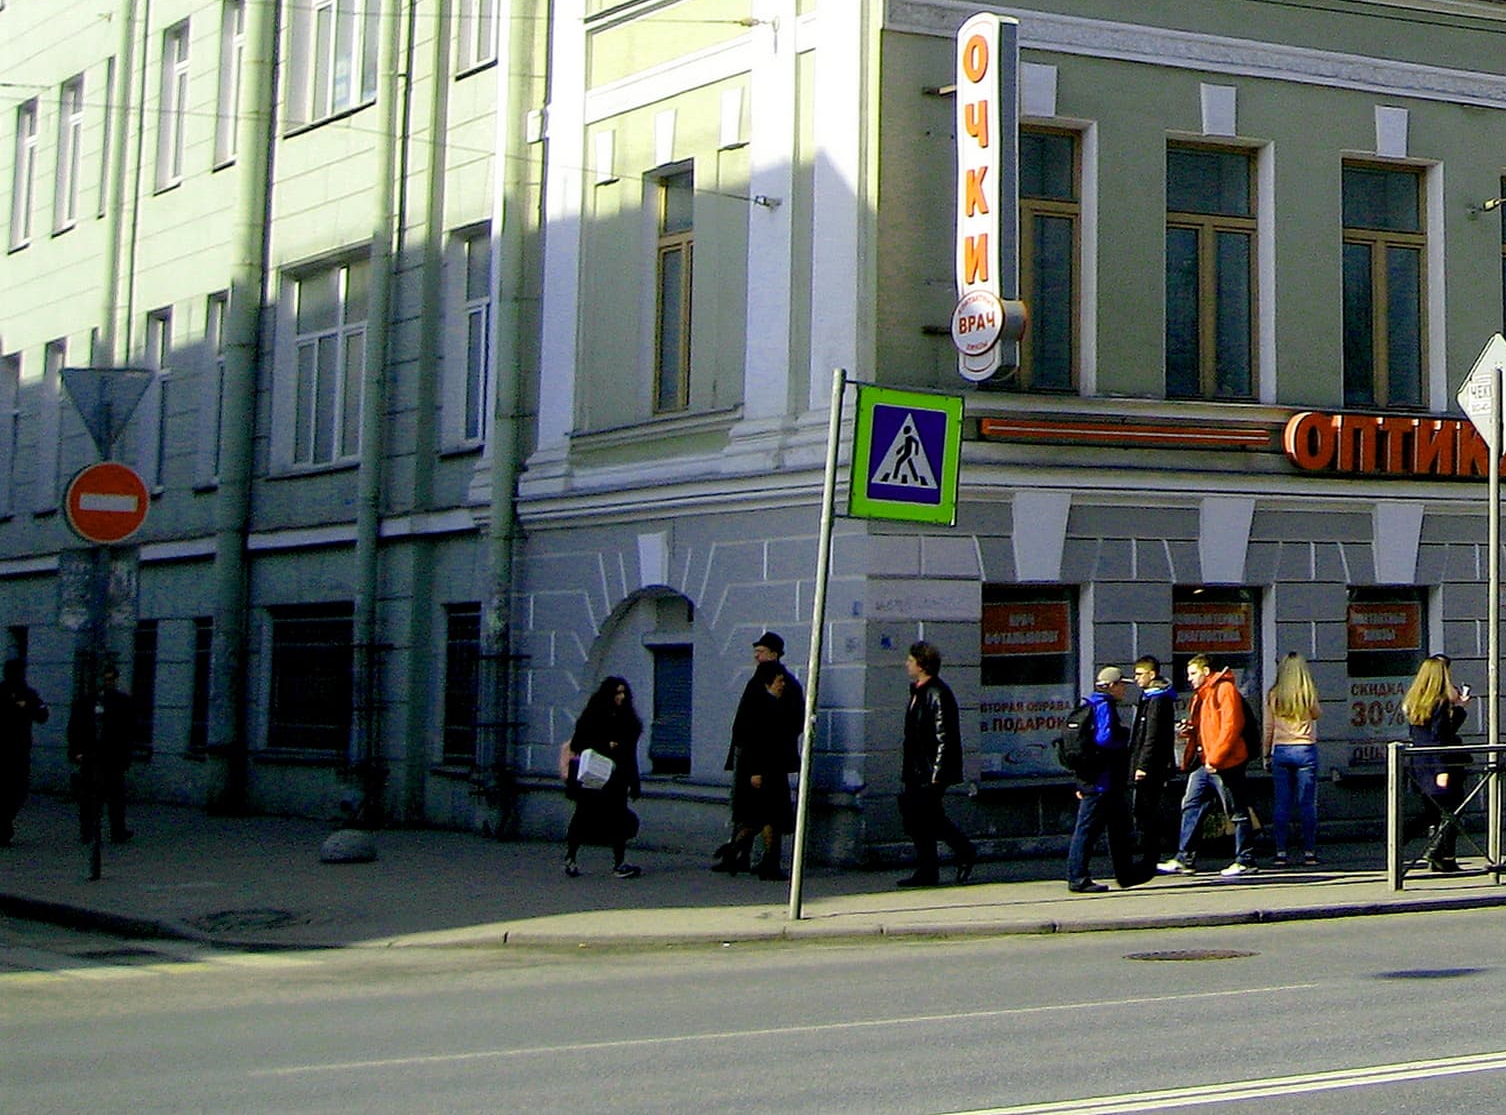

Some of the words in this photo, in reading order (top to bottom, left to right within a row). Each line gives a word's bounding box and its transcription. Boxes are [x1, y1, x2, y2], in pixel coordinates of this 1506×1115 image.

[962, 34, 990, 285] ОЧКИ
[958, 311, 996, 335] ВРАЧ
[1351, 682, 1405, 697] СКИДКА
[980, 701, 1024, 714] ВТОРАЯ
[1351, 701, 1406, 728] 30%
